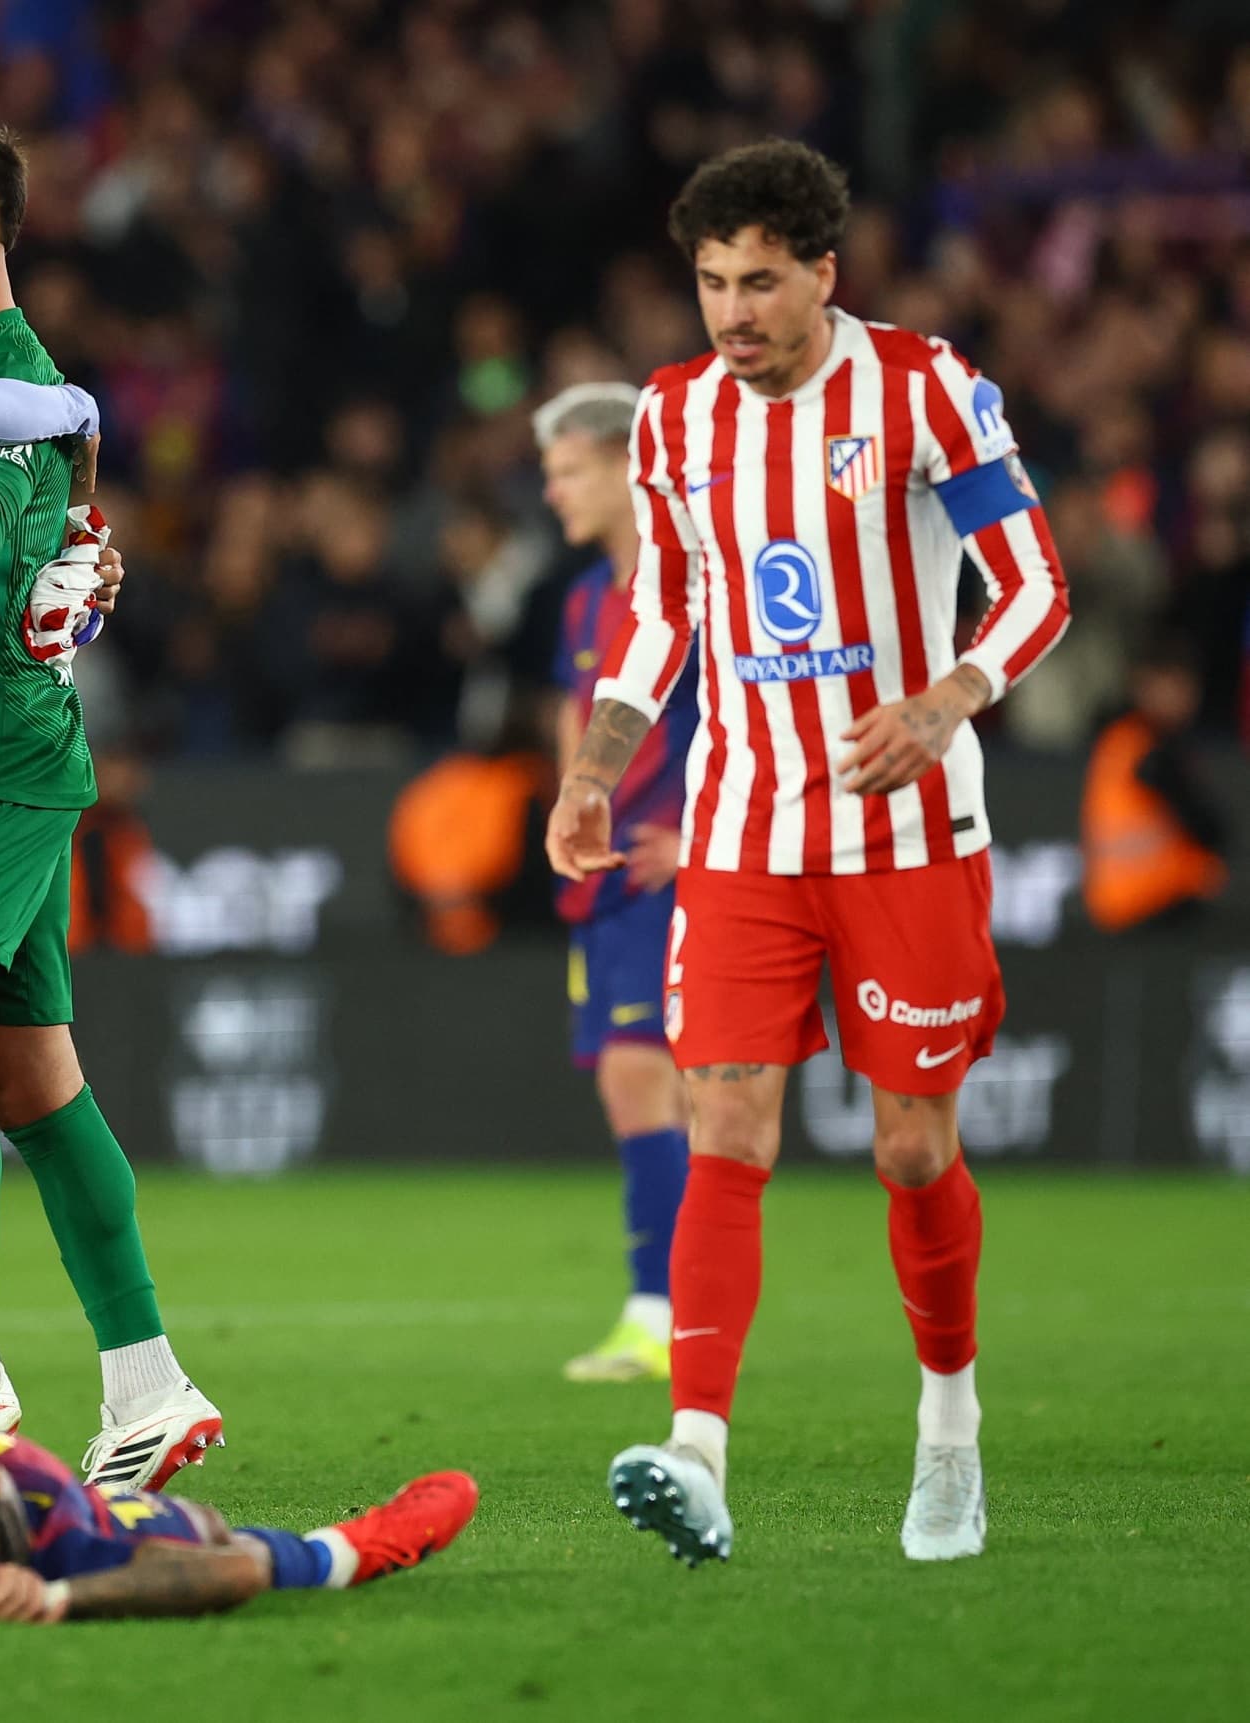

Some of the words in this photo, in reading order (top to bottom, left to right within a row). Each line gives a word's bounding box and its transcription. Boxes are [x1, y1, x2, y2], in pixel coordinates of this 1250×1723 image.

[735, 651, 823, 682] RIYADH
[828, 643, 871, 675] AIR
[668, 905, 687, 986] 2
